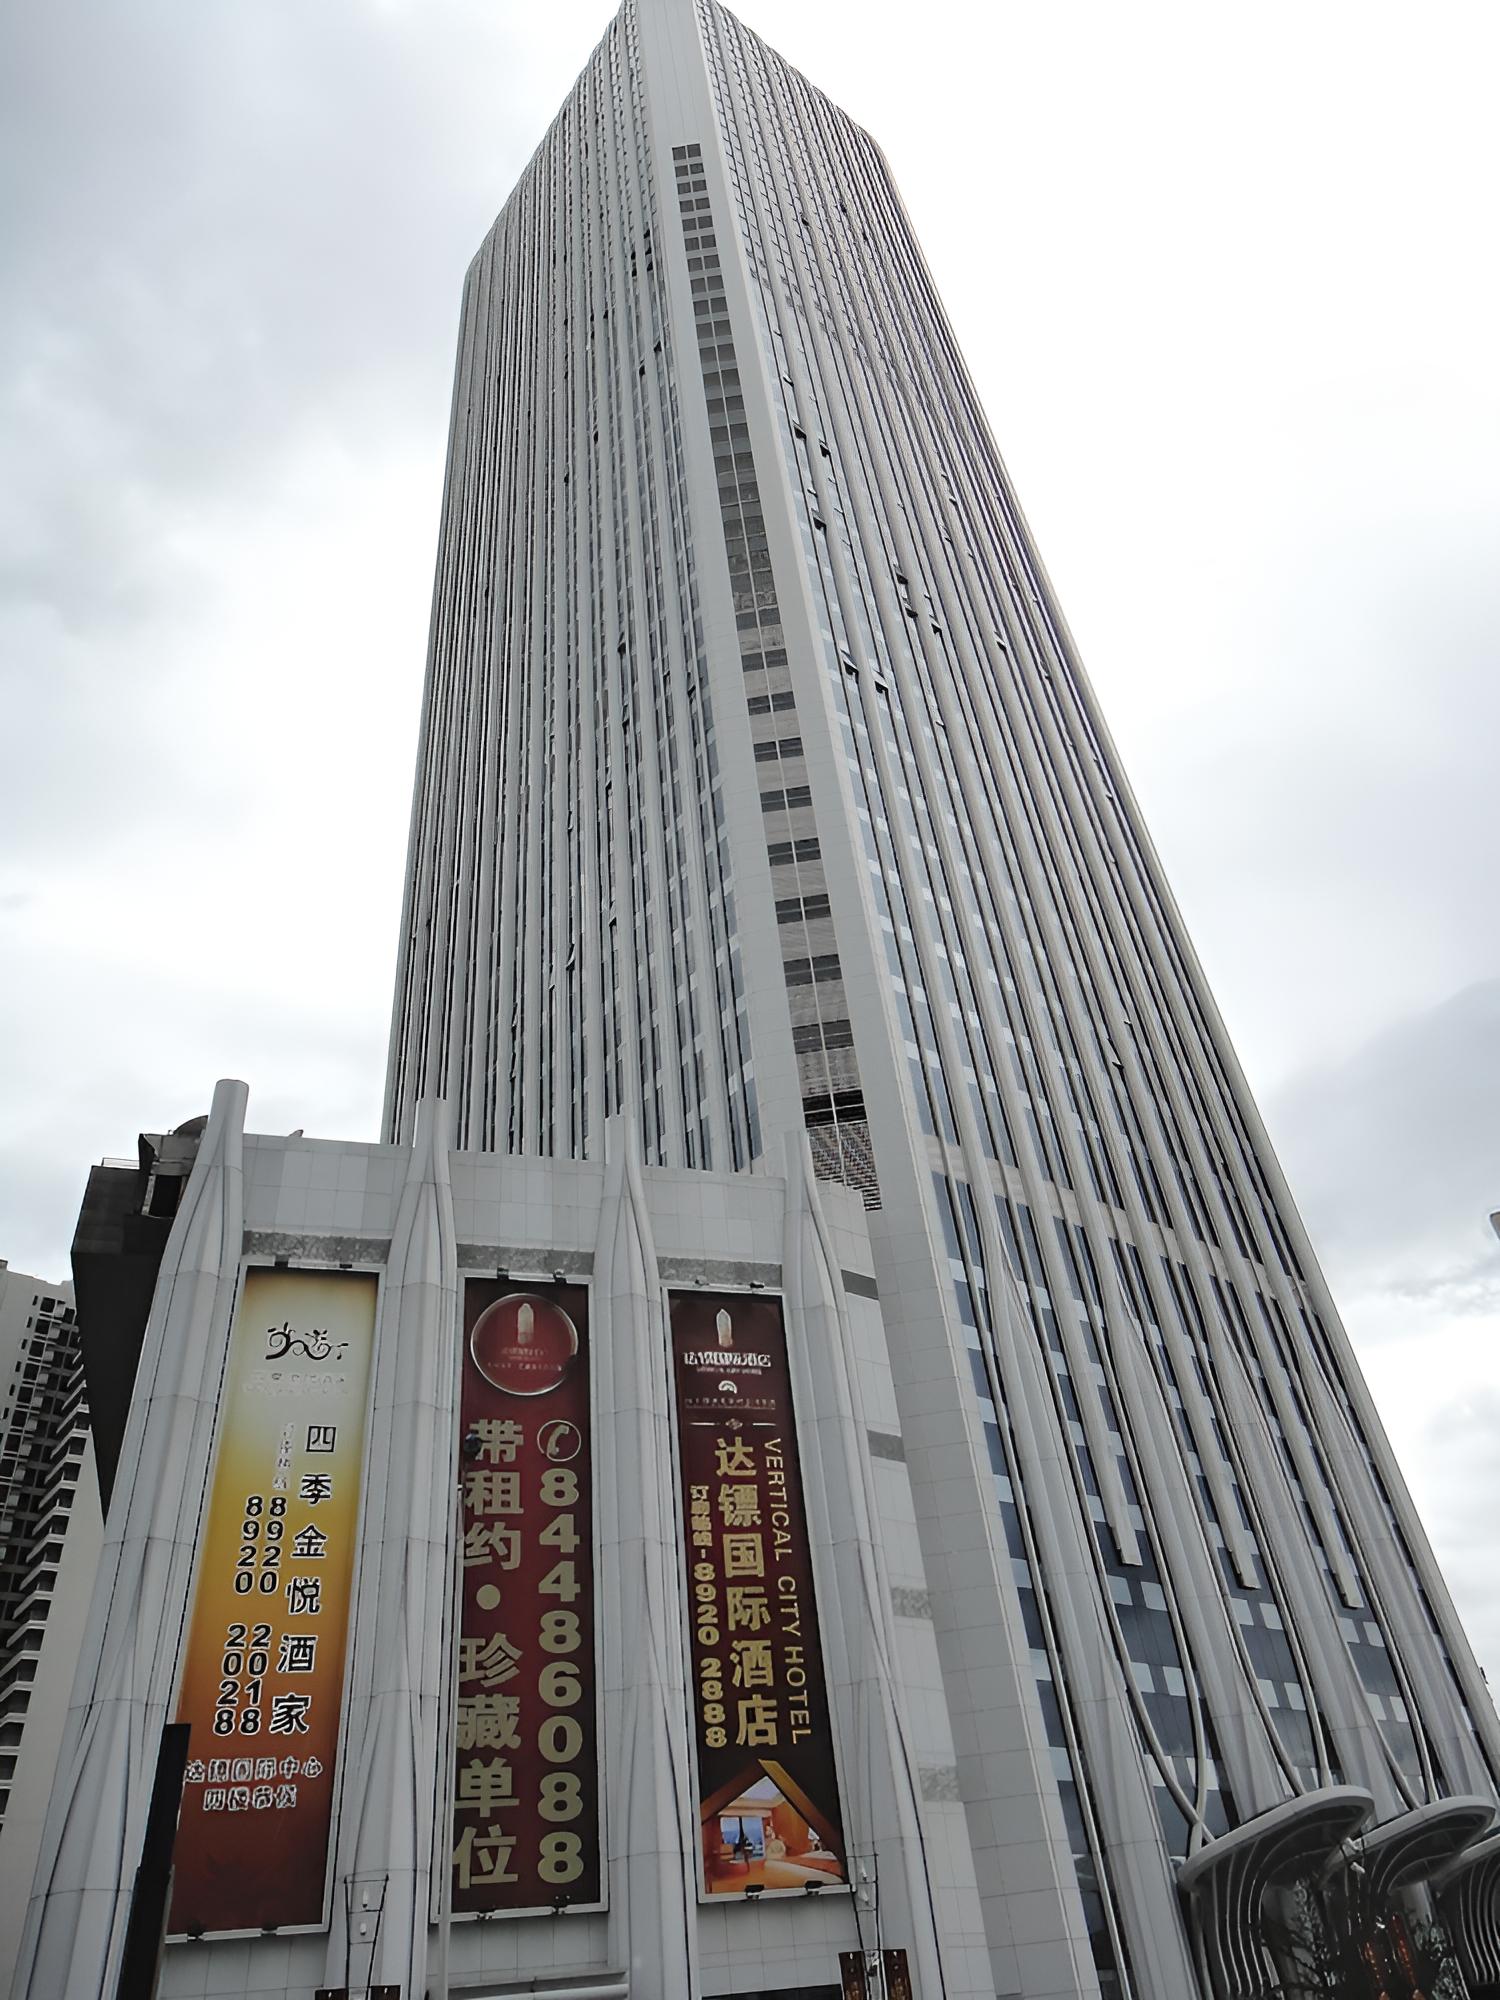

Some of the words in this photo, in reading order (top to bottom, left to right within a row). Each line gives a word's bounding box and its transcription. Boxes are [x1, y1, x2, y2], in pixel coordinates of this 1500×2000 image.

[764, 1438, 793, 1562] VERTICAL
[269, 1425, 337, 1735] 四季金悦酒家
[777, 1575, 803, 1638] CITY
[537, 1468, 584, 1884] 84486088
[784, 1646, 812, 1745] HOTEL
